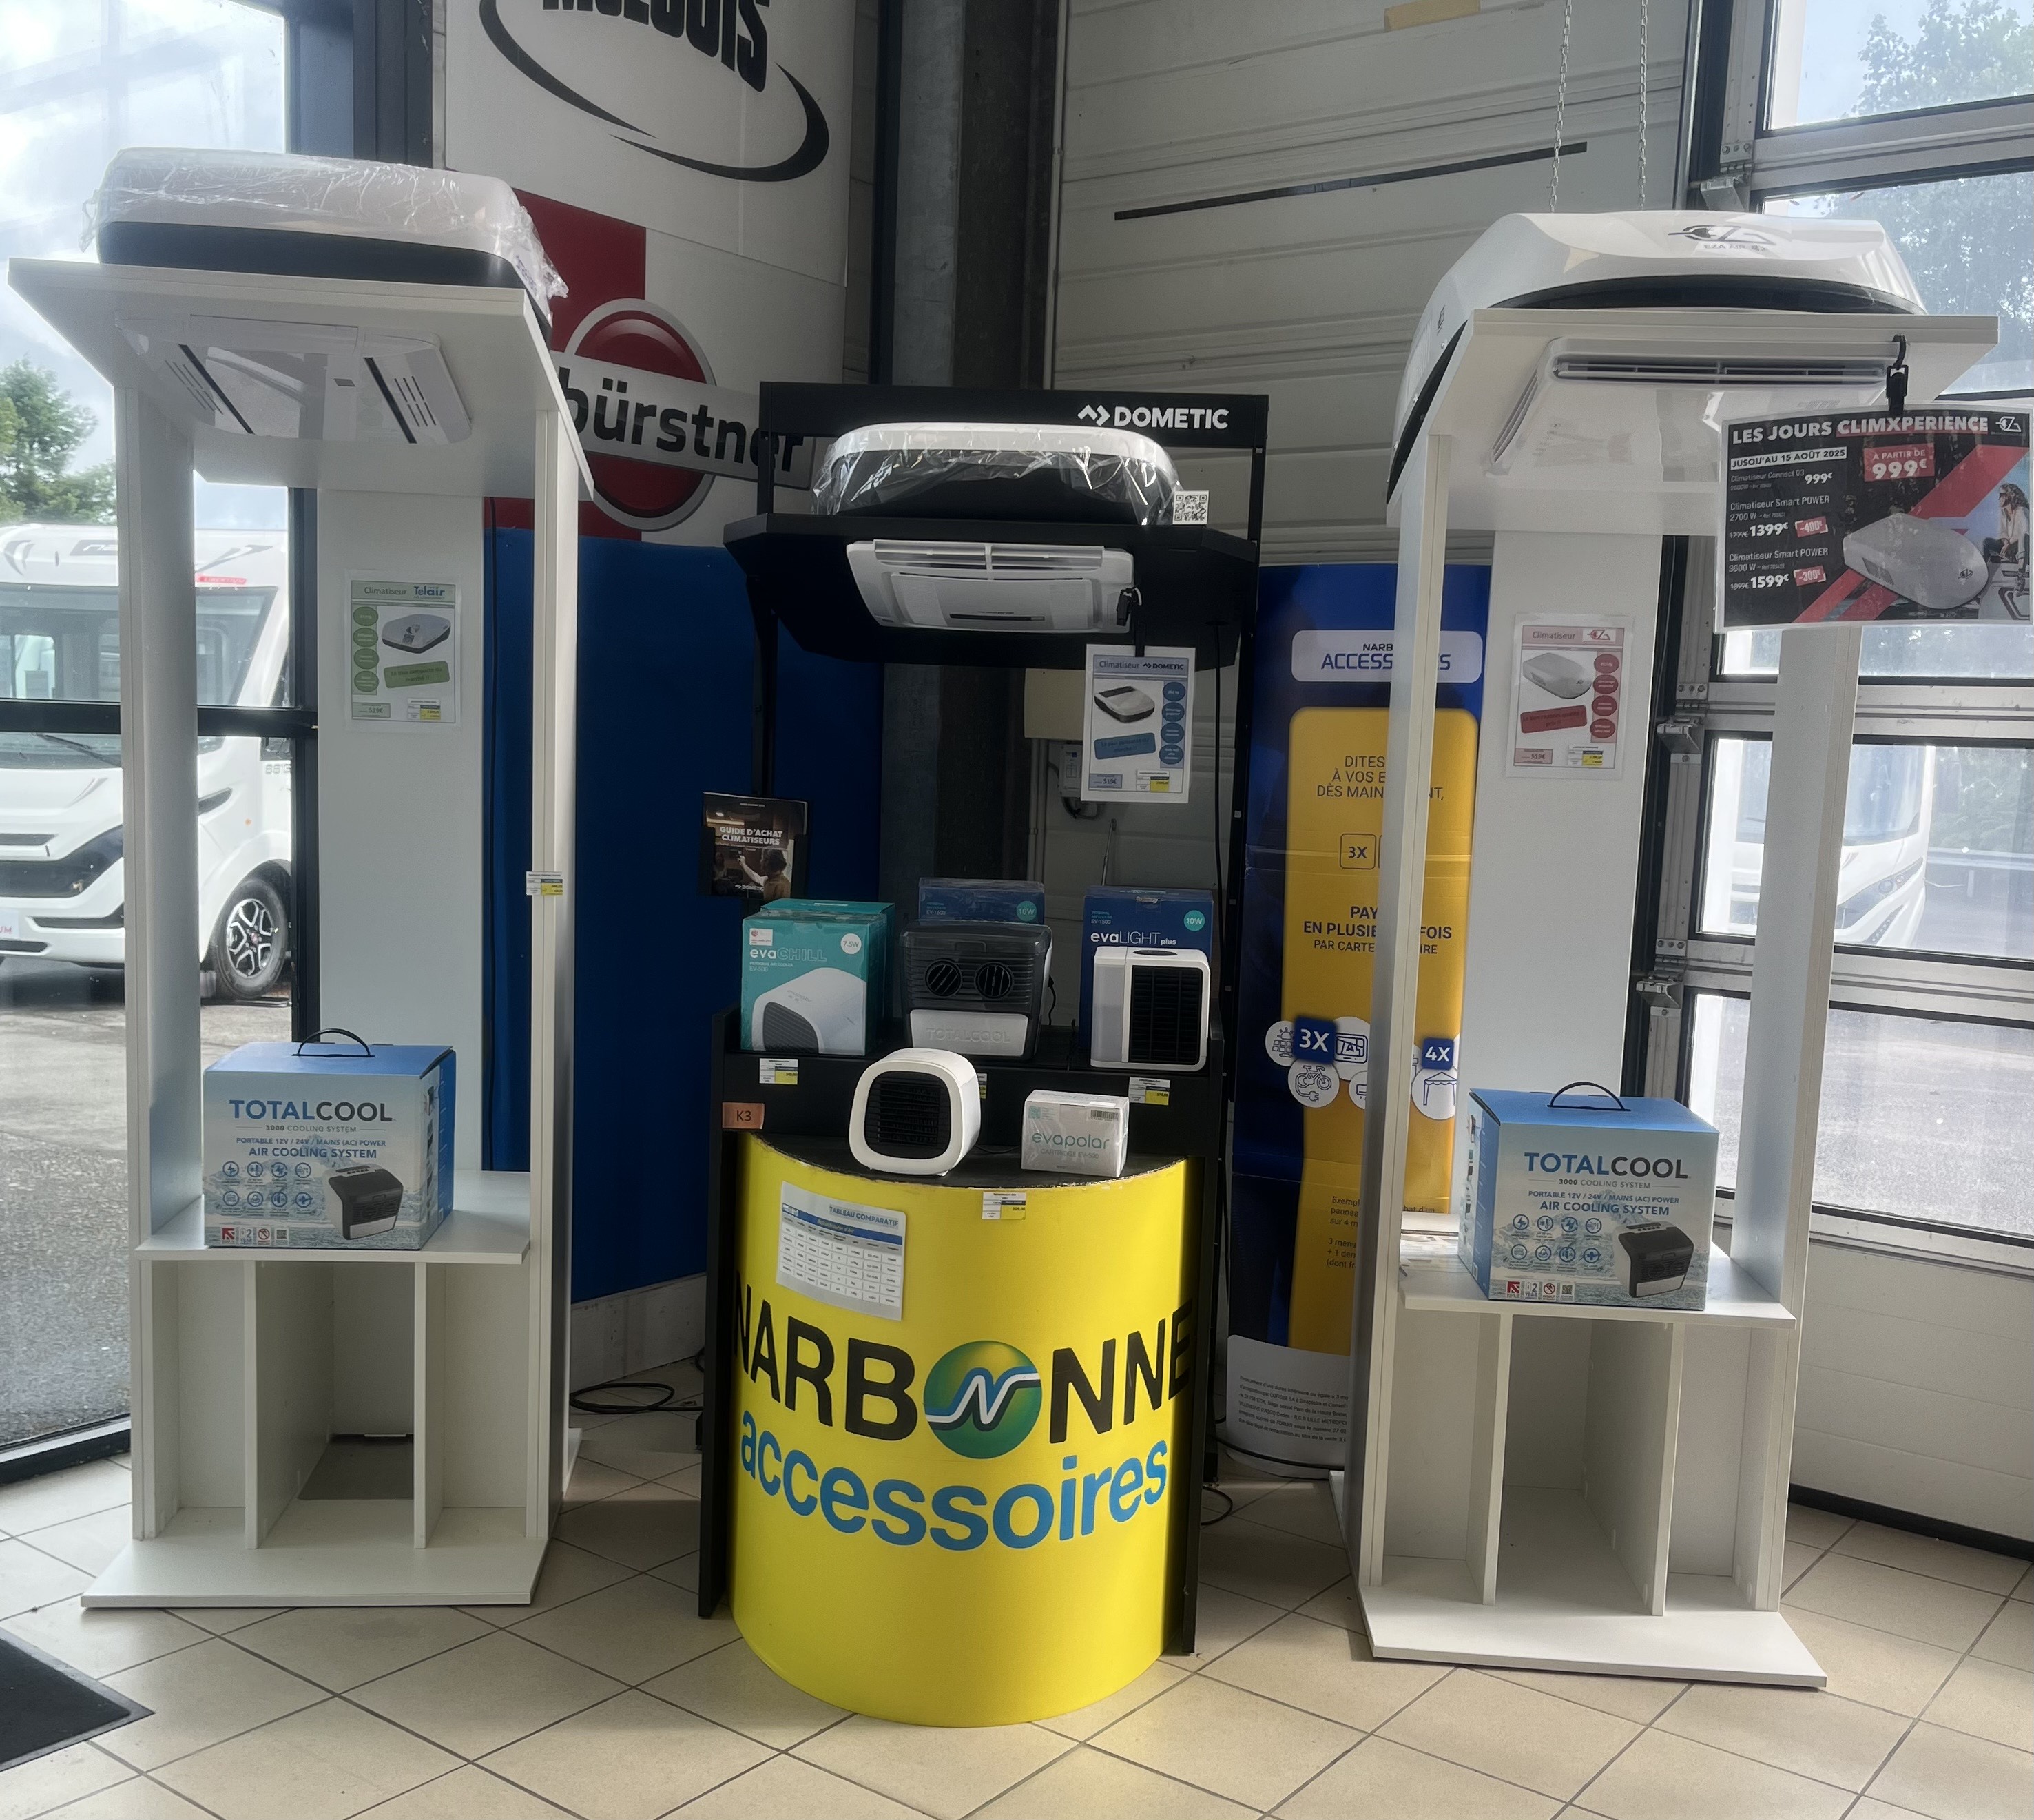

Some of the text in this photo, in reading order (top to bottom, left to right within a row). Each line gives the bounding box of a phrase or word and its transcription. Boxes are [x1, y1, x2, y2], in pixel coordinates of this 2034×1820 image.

[1114, 406, 1229, 429] DOMETIC
[1732, 416, 1988, 444] LES JOURS CLIMXPERIENCE
[1732, 449, 1845, 468] JUSQU'AU 15 AOÛT 2025
[1872, 449, 1926, 460] À PARTIR DE
[1731, 473, 1767, 482] Climatiseur
[1767, 470, 1794, 479] Connect
[1872, 459, 1927, 480] 999€
[1805, 472, 1833, 484] 999€
[1730, 495, 1830, 511] Climatiseur Smart POWER
[1730, 513, 1749, 522] 2700
[1750, 521, 1789, 537] 1399€
[1729, 547, 1829, 561] Climatiseur Smart POWER
[1728, 563, 1756, 572] 3600 W
[1750, 573, 1789, 588] 1599€
[364, 586, 446, 597] Climatiseur Telair
[1532, 630, 1576, 640] Climatiseur
[1363, 643, 1393, 652] NARB
[1099, 660, 1140, 669] Climatiseur
[1321, 653, 1451, 670] ACCESSS
[1345, 756, 1385, 768] DITES
[1332, 767, 1342, 783] À
[1345, 771, 1374, 783] VOS
[1317, 783, 1343, 798] DÈS
[720, 827, 783, 838] GUIDE D'ACHAT
[721, 834, 780, 845] CLIMATISEURS
[1349, 849, 1367, 859] 3X
[1350, 906, 1378, 920] PAY
[1303, 921, 1322, 934] EN
[1327, 923, 1377, 938] PLUSIE
[842, 940, 860, 949] 7.5W
[1090, 931, 1177, 946] evaLIGHT plus
[1314, 940, 1375, 953] PAR CARTE
[749, 947, 827, 962] evaCHILL
[925, 1027, 1010, 1044] TOTALCOOL
[1299, 1028, 1330, 1053] 3X
[1424, 1046, 1451, 1062] 4X
[229, 1099, 393, 1122] TOTALCOOL
[737, 1110, 751, 1121] K3
[1032, 1133, 1110, 1150] evapolar
[249, 1147, 377, 1159] AIR COOLING SYSTEM
[1040, 1148, 1077, 1157] CARTRIDGE
[1524, 1152, 1688, 1179] TOTALCOOL
[1580, 1179, 1617, 1188] COOLING
[1528, 1190, 1565, 1199] PORTABLE
[1331, 1195, 1360, 1208] Exempl
[1330, 1208, 1359, 1218] pannea
[1539, 1201, 1670, 1216] AIR COOLING SYSTEM
[829, 1206, 899, 1226] TABLEAU COMPARATIF
[1327, 1237, 1333, 1245] 3
[1532, 1283, 1537, 1292] 2
[741, 1410, 1168, 1551] accessoires
